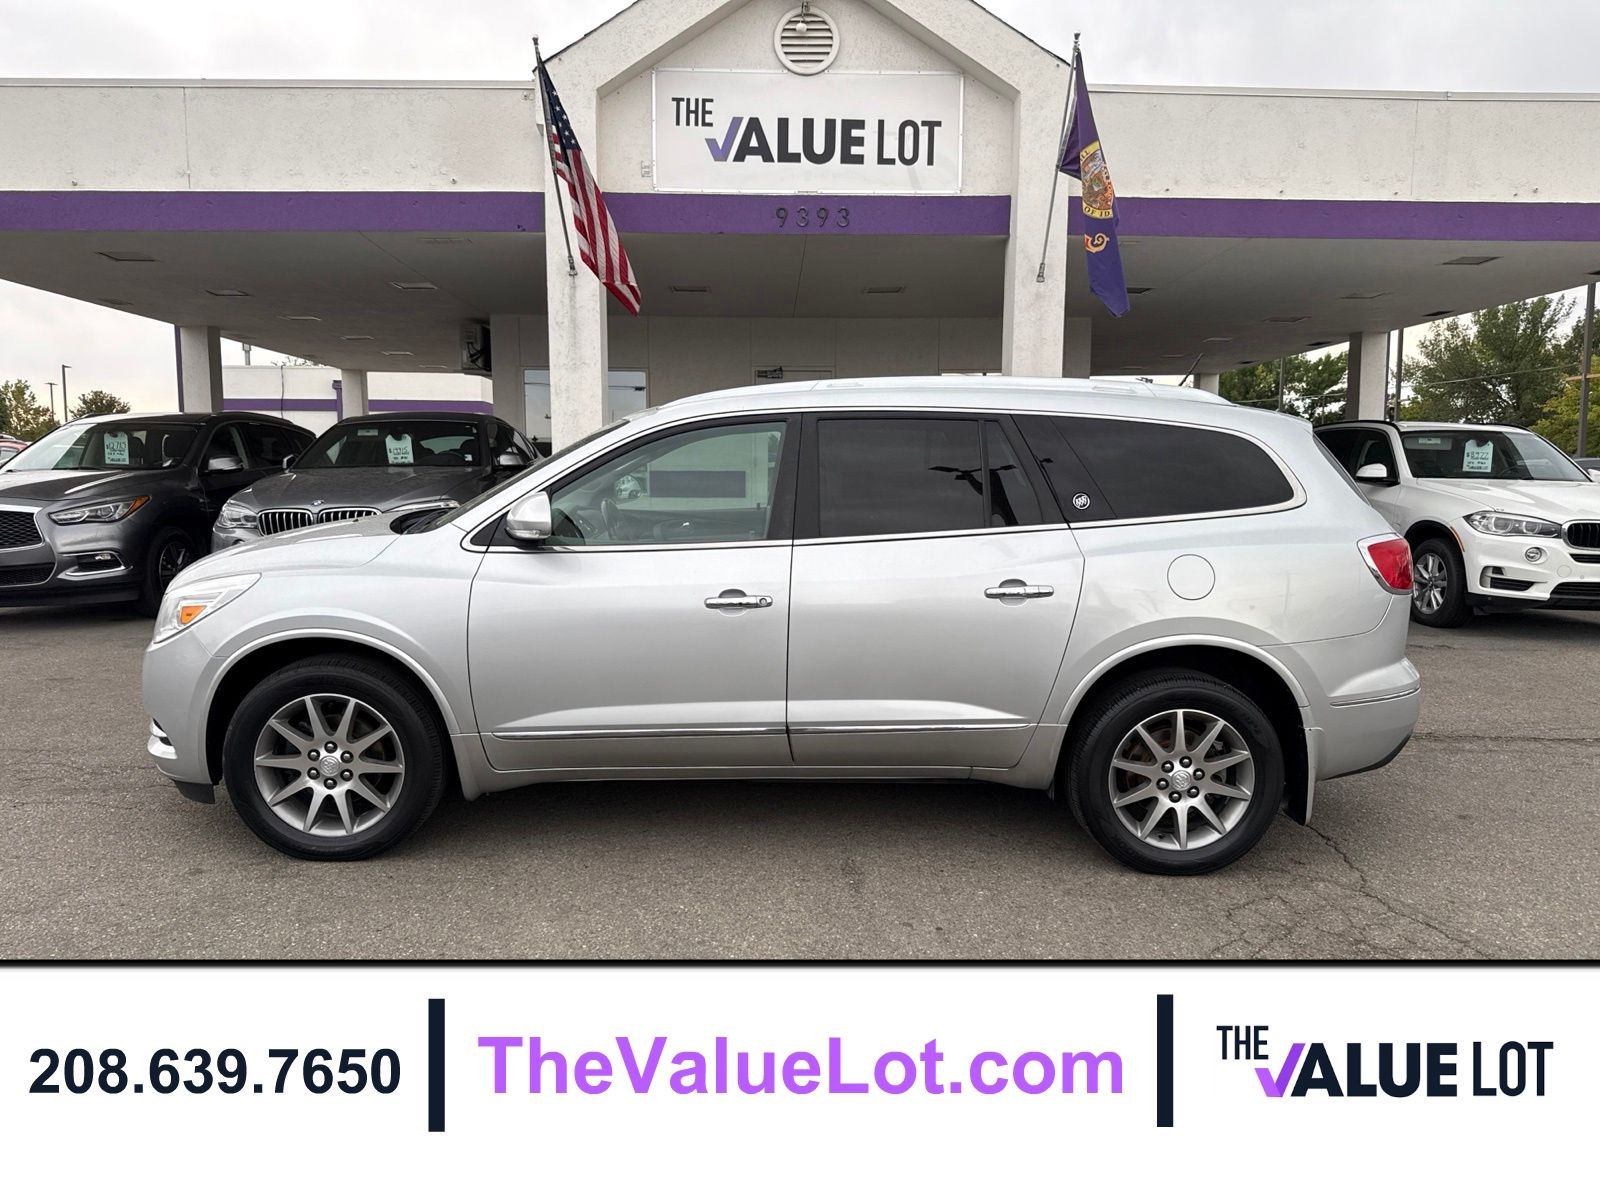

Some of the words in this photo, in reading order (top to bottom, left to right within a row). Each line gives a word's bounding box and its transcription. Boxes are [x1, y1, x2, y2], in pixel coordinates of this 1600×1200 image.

[671, 97, 713, 127] THE
[704, 116, 866, 165] VALUE
[876, 119, 942, 167] LOT
[775, 205, 850, 230] 9393
